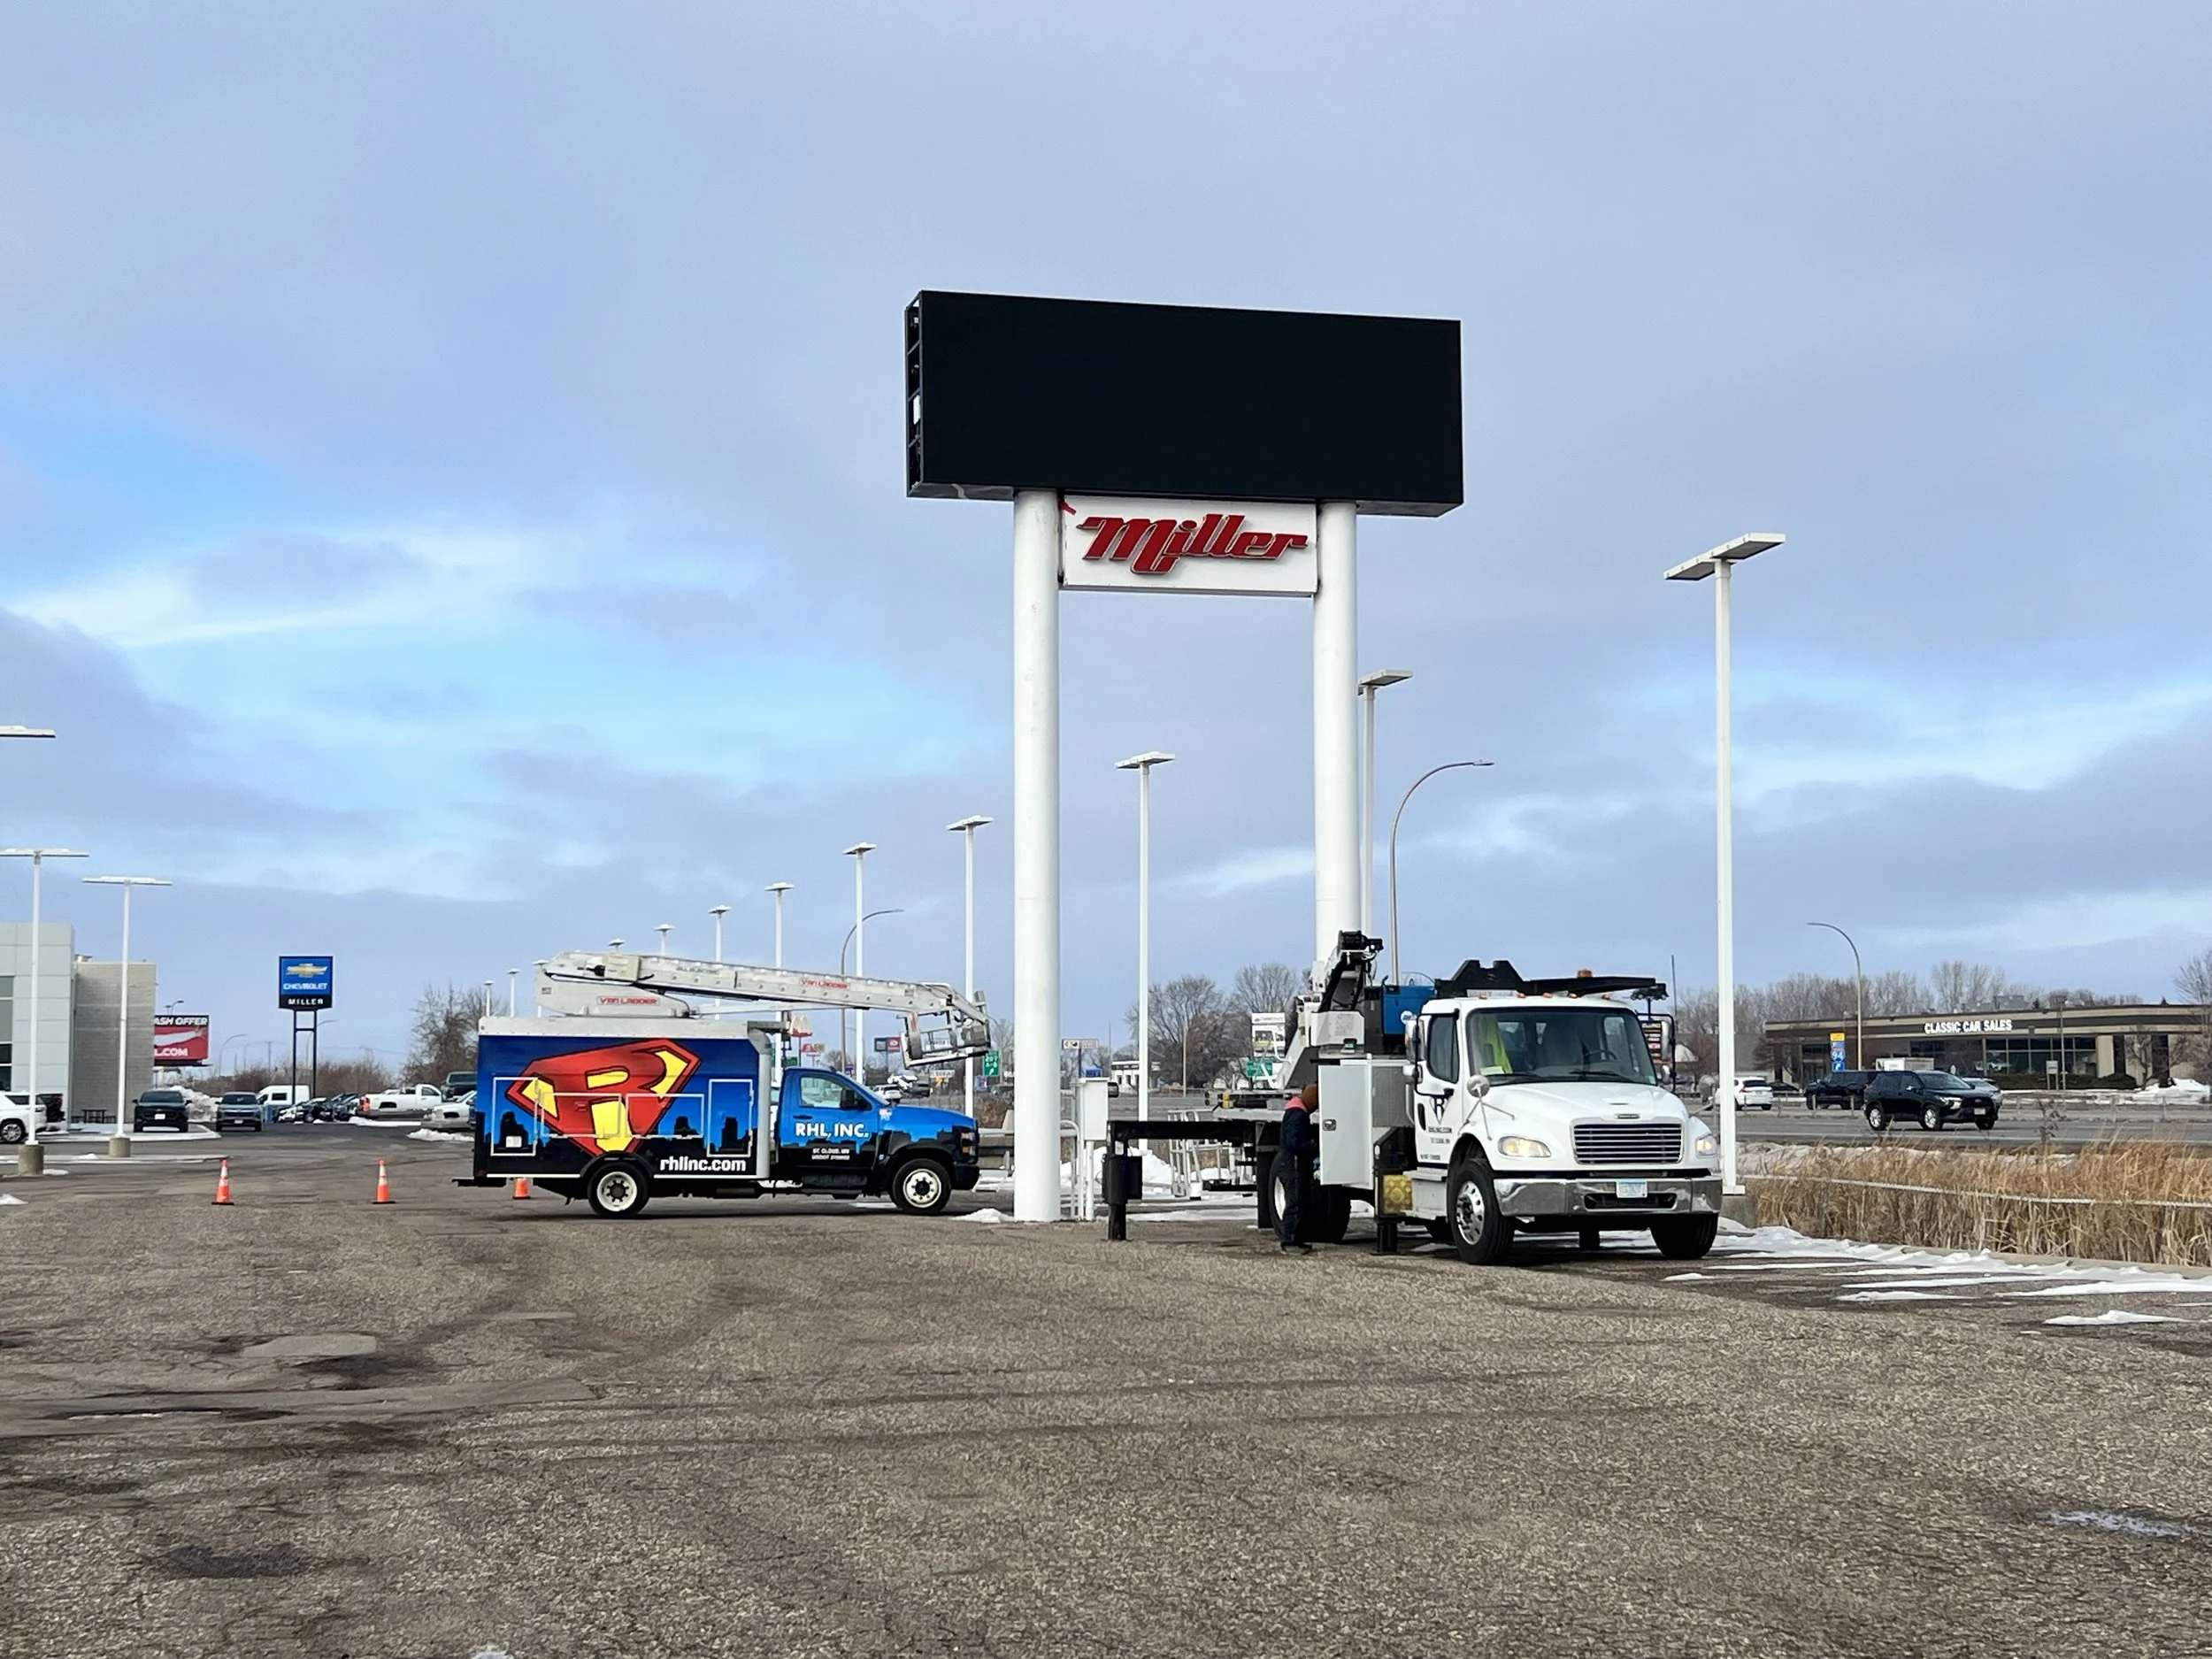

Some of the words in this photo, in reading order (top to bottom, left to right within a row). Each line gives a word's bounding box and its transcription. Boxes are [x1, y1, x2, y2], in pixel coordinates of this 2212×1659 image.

[1076, 513, 1309, 574] Miller
[154, 1017, 174, 1025] ASH
[175, 1017, 208, 1025] OFFER
[1924, 1021, 1962, 1034] CLASSIC
[1962, 1020, 1981, 1033] CAR
[1984, 1019, 2013, 1032] SALES
[154, 1048, 188, 1056] L.COM
[795, 1122, 832, 1140] RHL,
[834, 1123, 870, 1138] INC.
[659, 1156, 747, 1171] rhlinc.com
